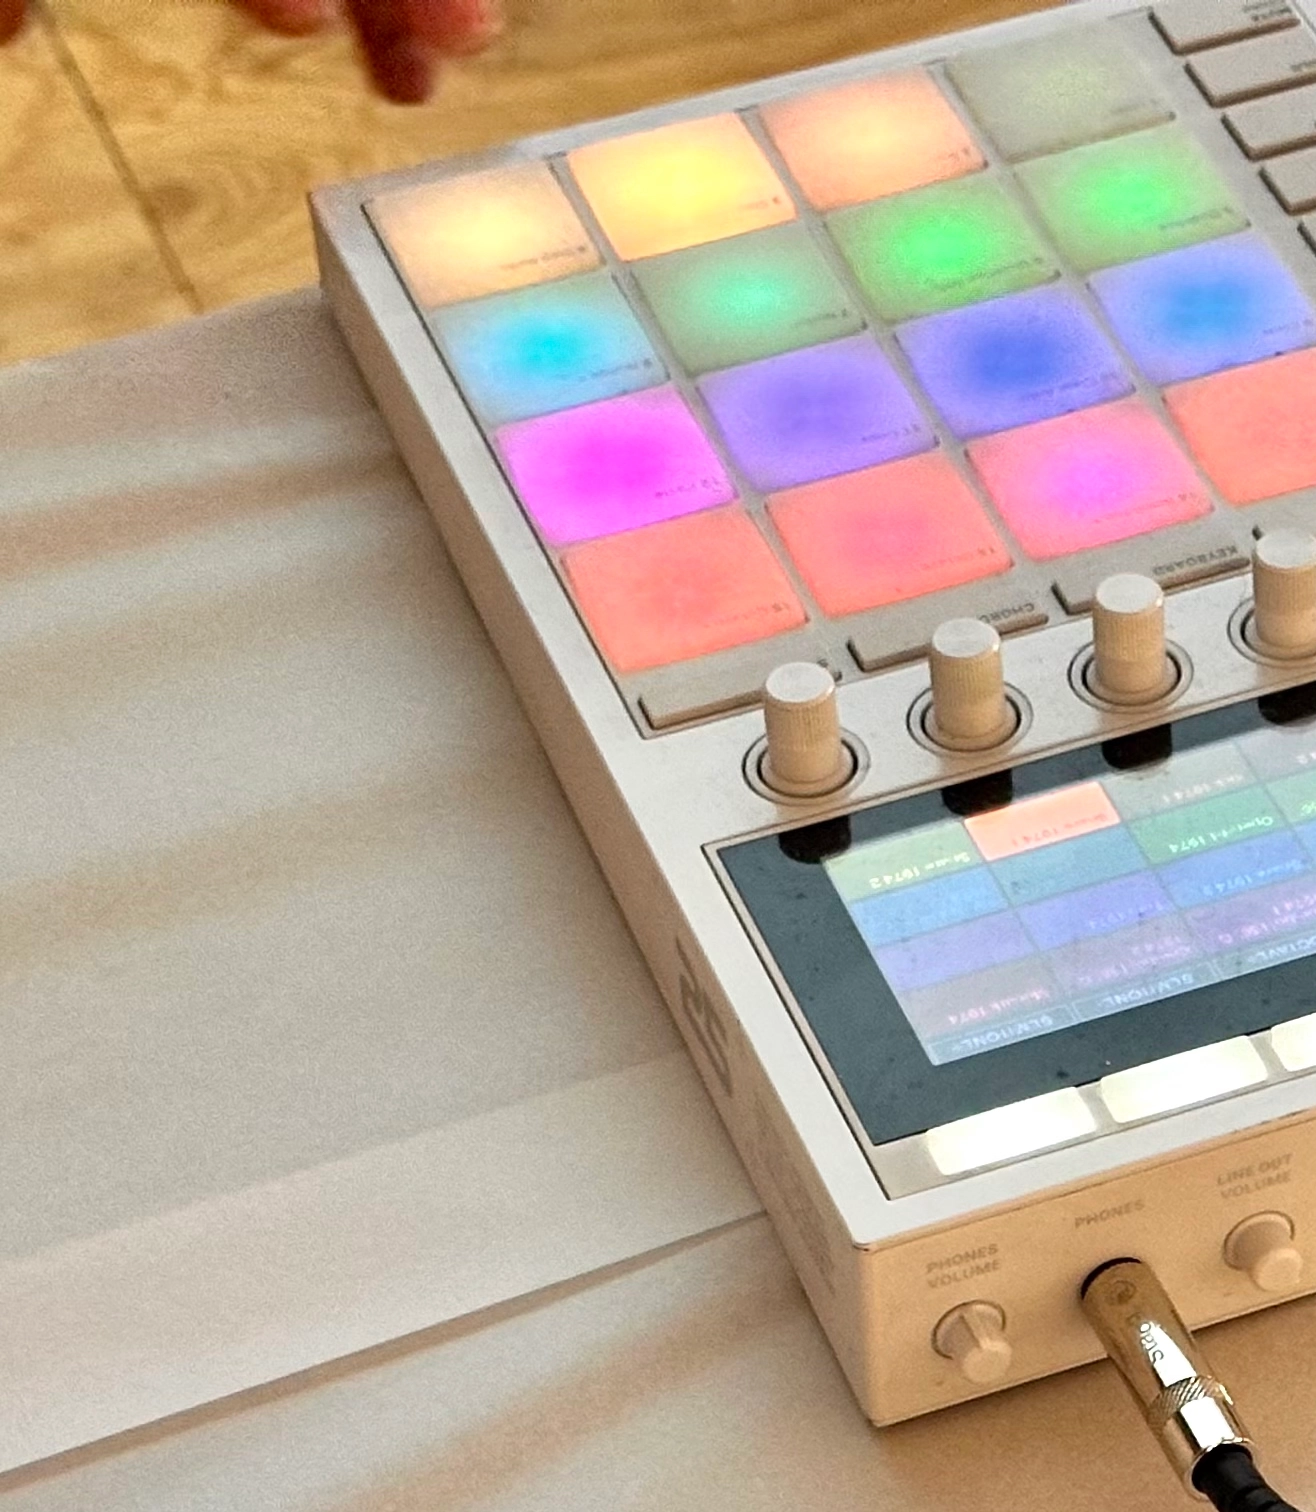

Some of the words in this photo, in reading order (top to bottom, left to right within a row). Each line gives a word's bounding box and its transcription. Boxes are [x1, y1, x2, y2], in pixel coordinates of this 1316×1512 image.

[1151, 545, 1238, 576] KEYBOARD
[978, 602, 1035, 625] CHORD
[1167, 834, 1206, 854] 1974
[1216, 1164, 1256, 1188] LINE
[1257, 1153, 1292, 1178] OUT
[1219, 1170, 1292, 1200] VOLUME
[1074, 1200, 1146, 1229] PHONES
[925, 1242, 999, 1275] PHONES
[927, 1260, 1001, 1289] VOLUME
